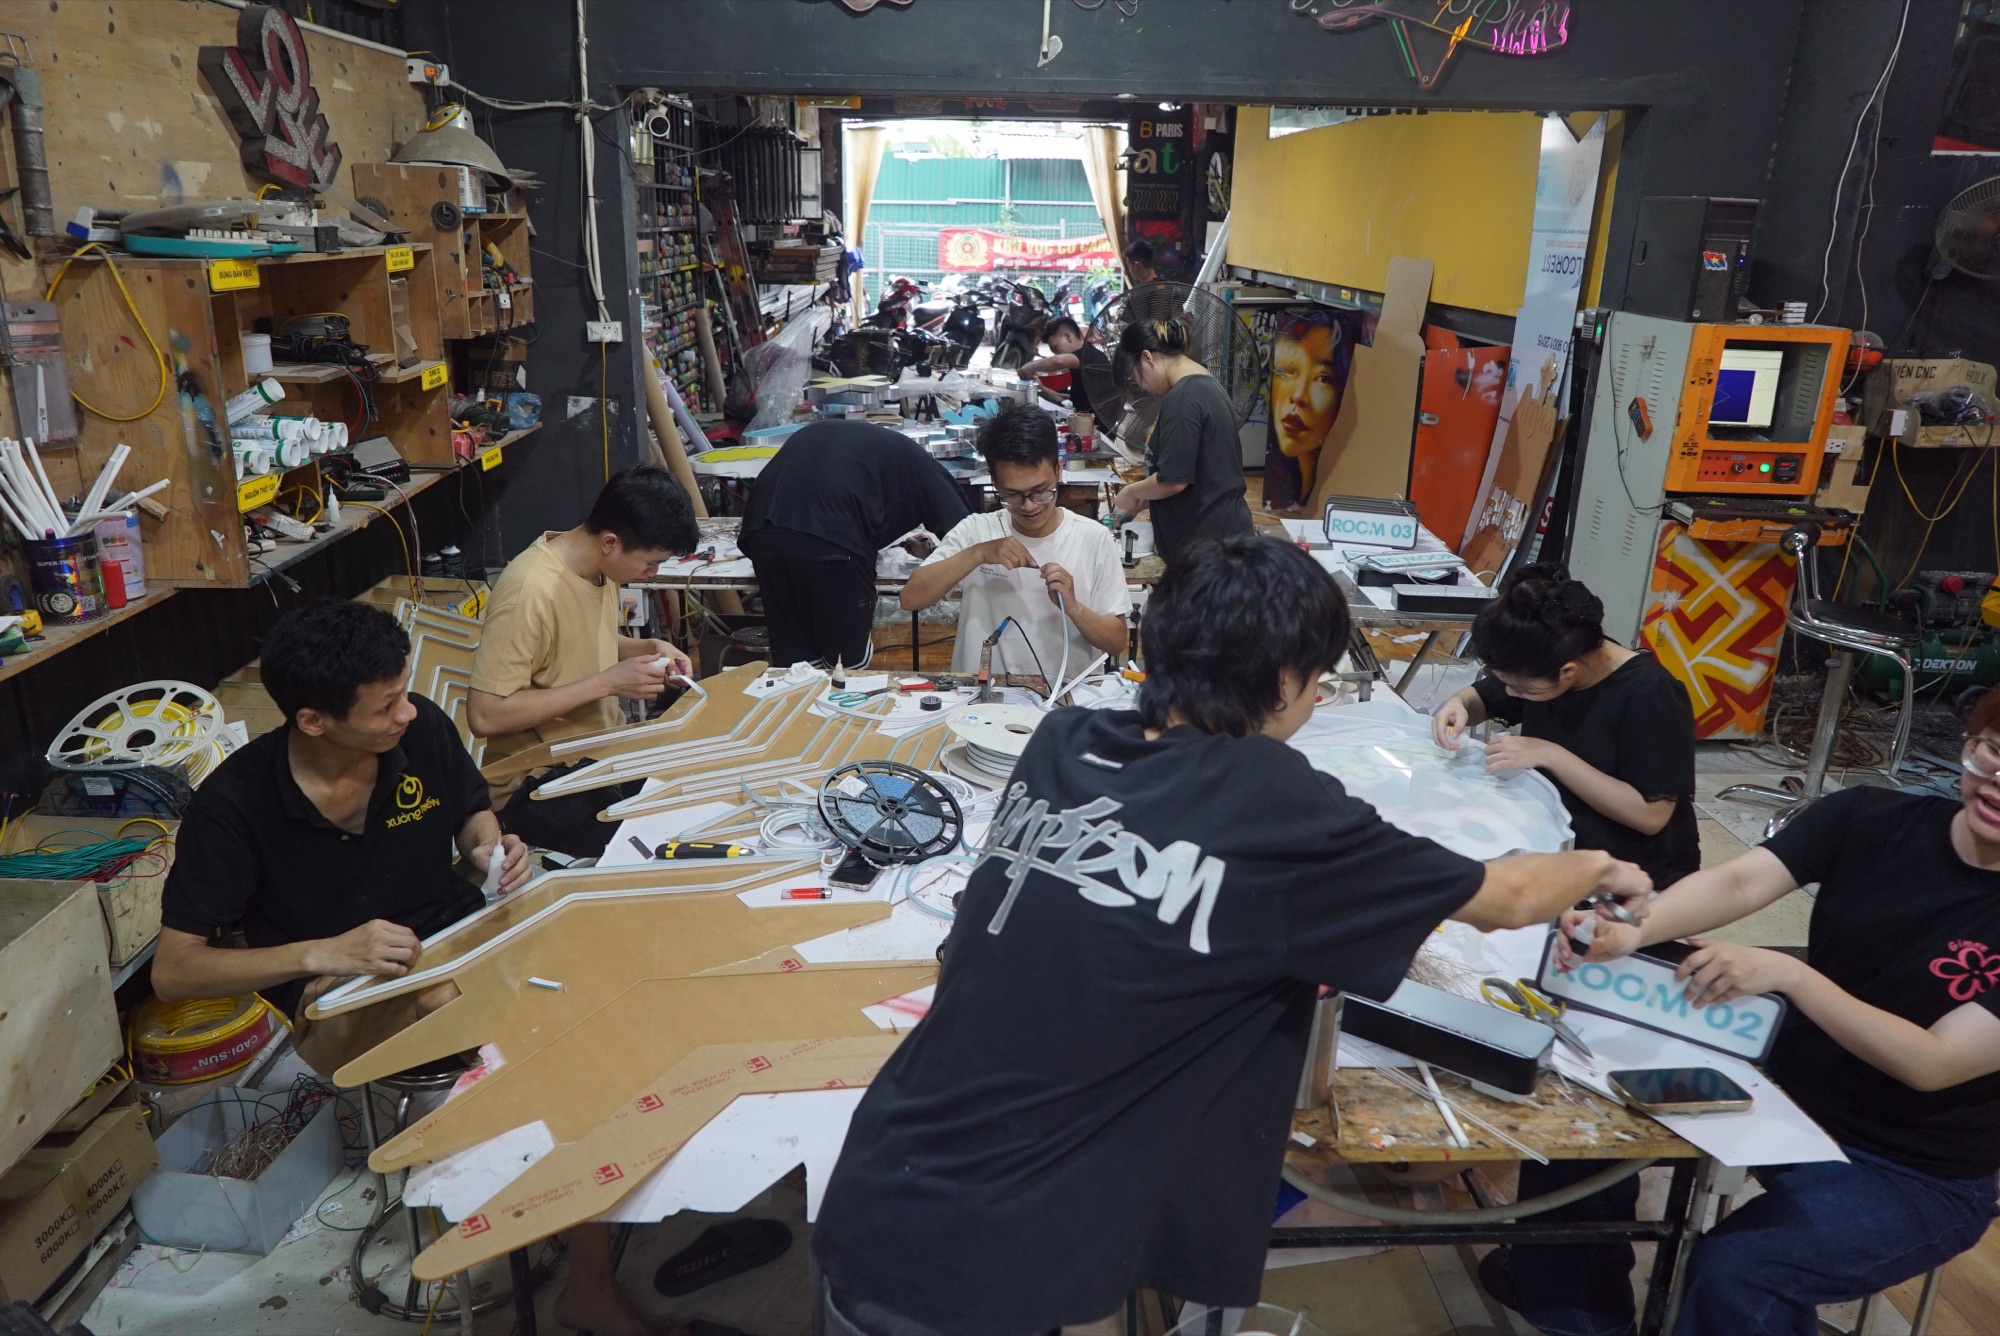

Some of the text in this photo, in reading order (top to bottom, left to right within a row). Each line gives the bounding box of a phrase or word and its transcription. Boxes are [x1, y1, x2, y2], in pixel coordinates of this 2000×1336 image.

[1140, 121, 1183, 138] B PARIS
[1915, 366, 1938, 379] CNC
[1390, 524, 1412, 539] 03
[1922, 658, 1978, 670] DEKTON
[1705, 1002, 1763, 1042] 02
[34, 1167, 116, 1249] 3000K 4000K
[40, 1181, 121, 1264] 6000K 10000K
